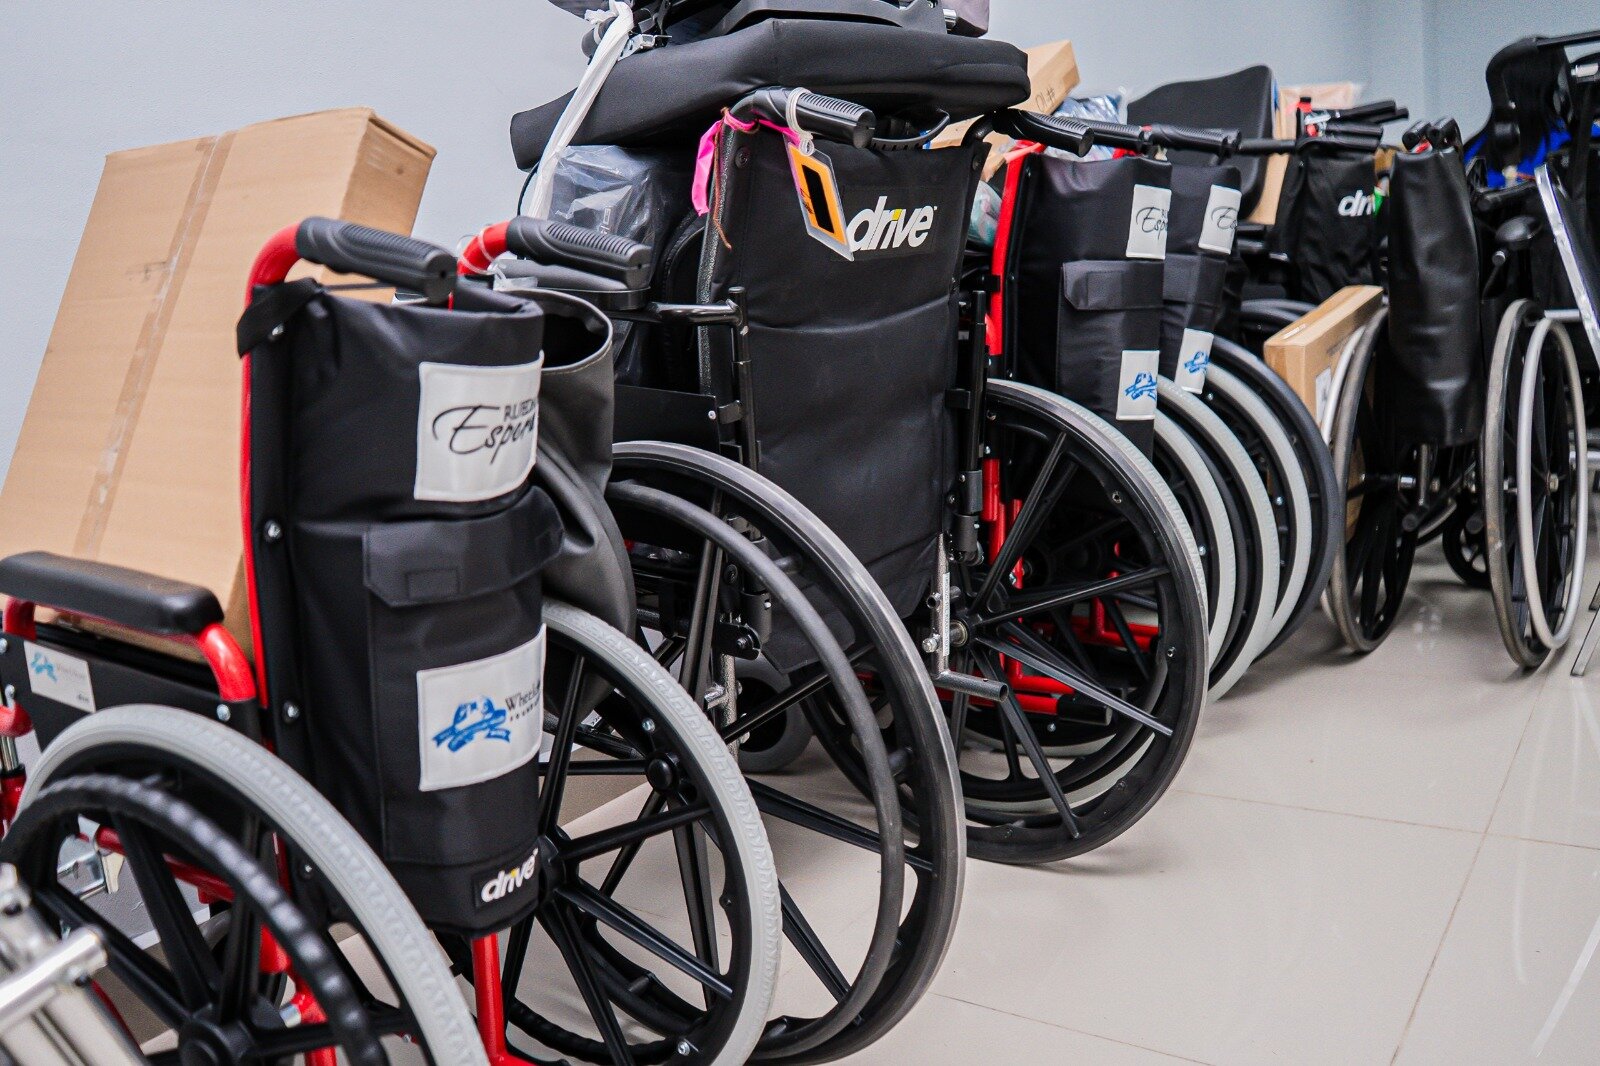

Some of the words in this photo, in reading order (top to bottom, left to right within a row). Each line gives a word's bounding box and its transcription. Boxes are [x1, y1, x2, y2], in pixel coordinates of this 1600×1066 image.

[846, 196, 936, 250] drive
[1136, 206, 1167, 240] Esp
[1338, 190, 1375, 217] dri
[481, 852, 537, 902] drive
